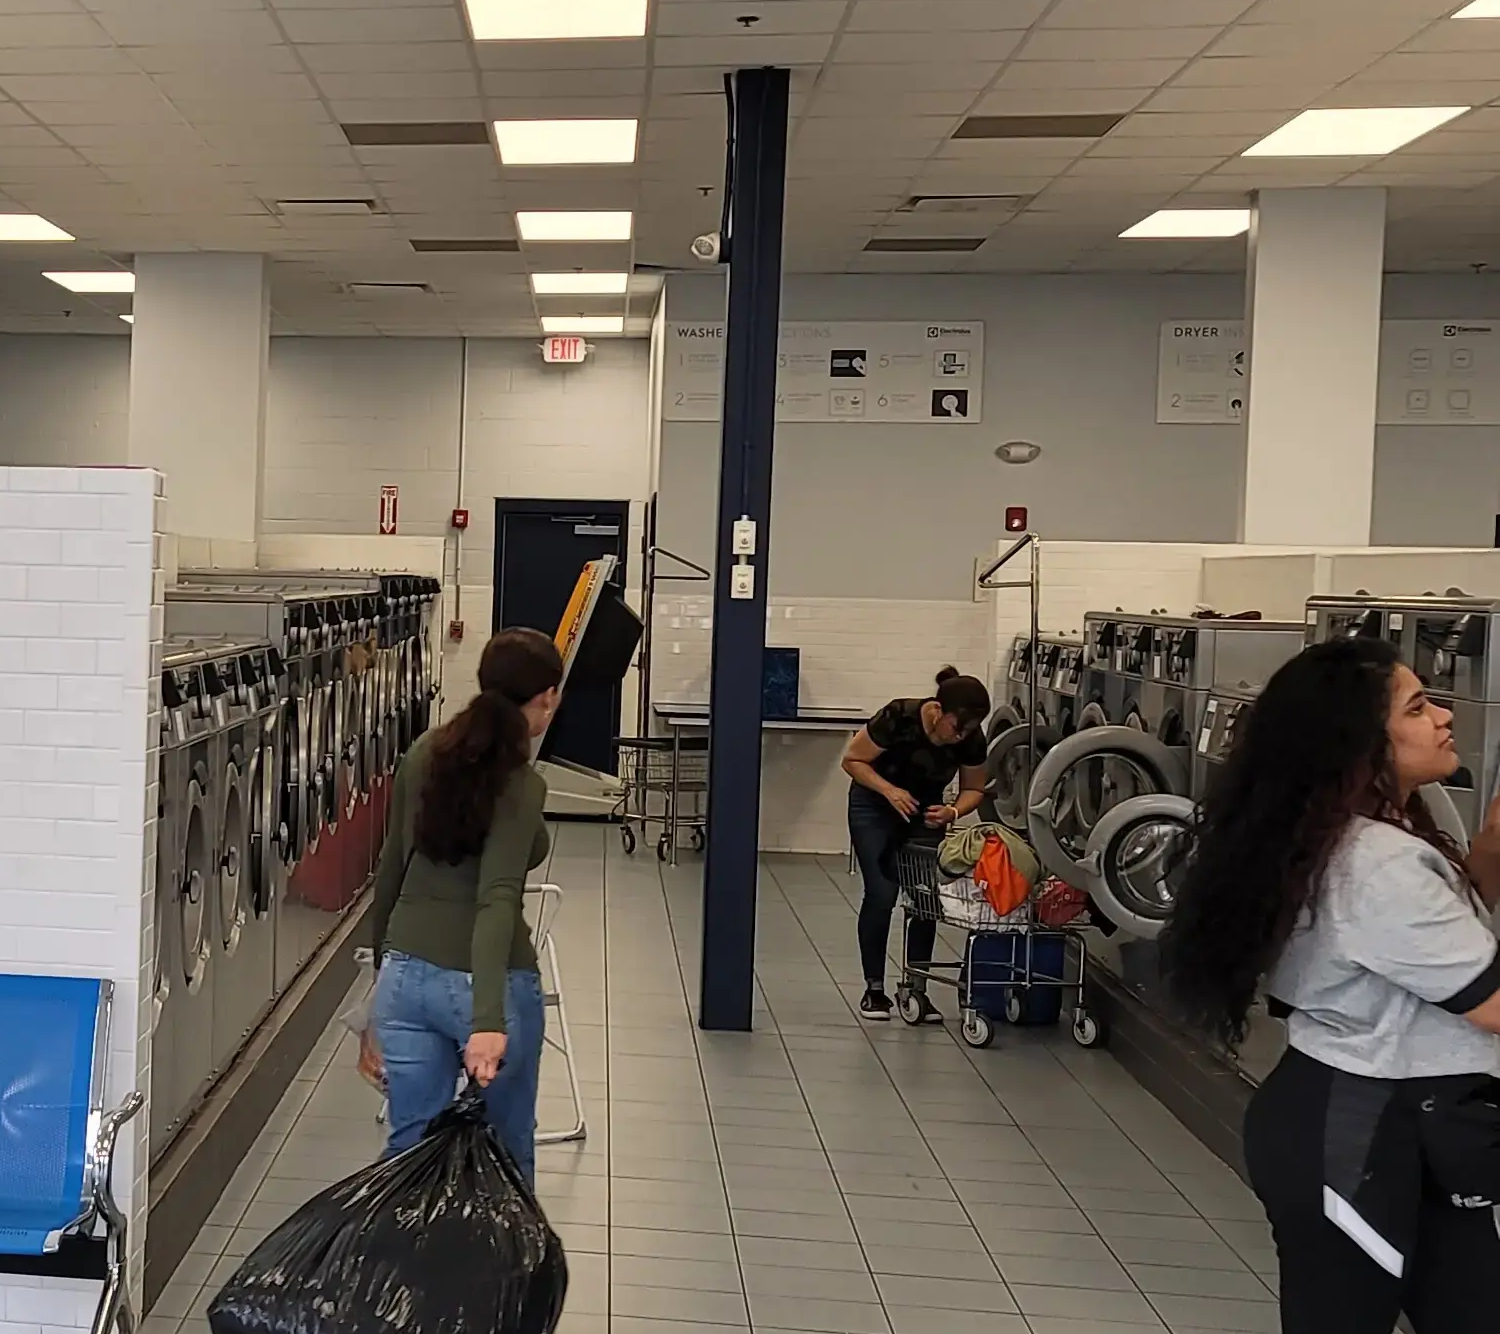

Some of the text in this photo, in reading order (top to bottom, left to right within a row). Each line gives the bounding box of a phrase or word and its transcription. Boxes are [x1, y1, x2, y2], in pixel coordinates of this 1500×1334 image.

[678, 327, 723, 338] WASHE
[1174, 327, 1219, 338] DRYER
[551, 338, 580, 360] EXIT
[674, 392, 685, 406] 2
[877, 393, 888, 407] 6
[1171, 393, 1182, 408] 2
